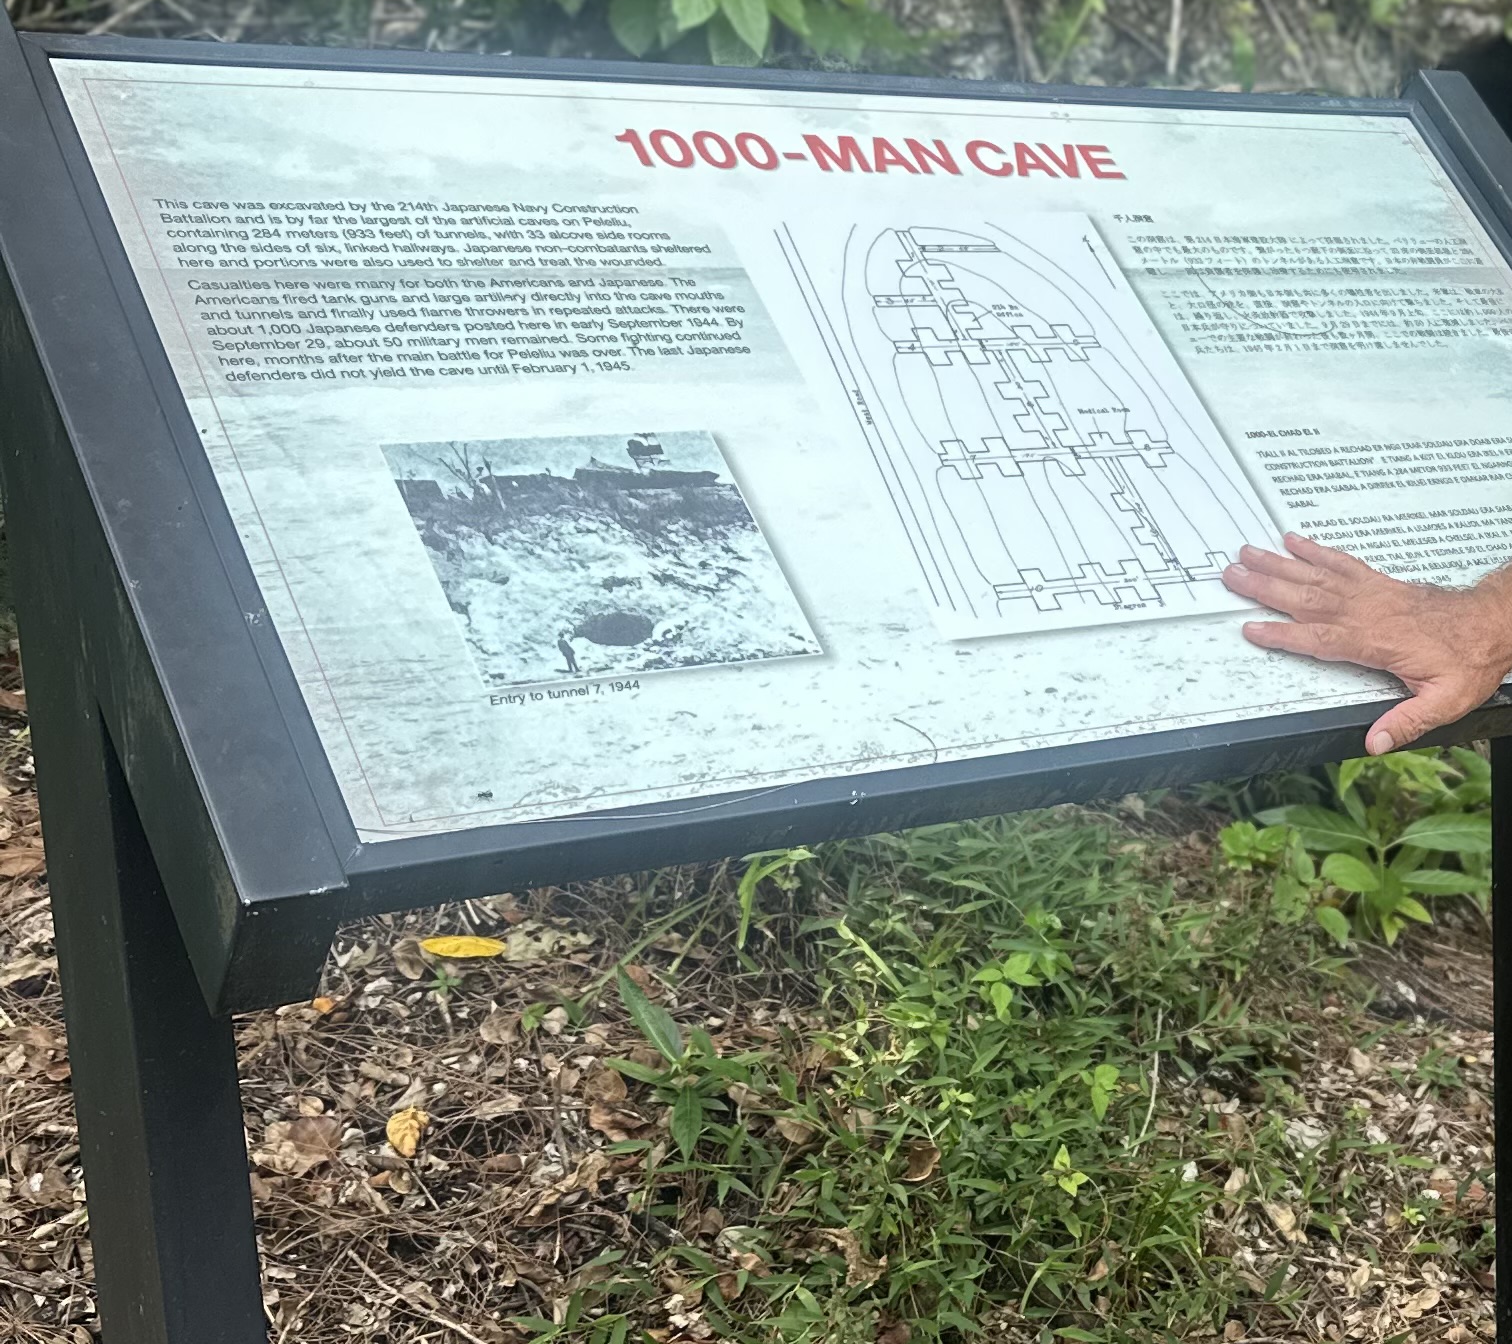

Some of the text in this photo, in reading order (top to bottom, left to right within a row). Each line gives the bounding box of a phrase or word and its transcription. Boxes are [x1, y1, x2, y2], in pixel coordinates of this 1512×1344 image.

[615, 127, 1126, 180] 1000-MAN CAVE
[153, 199, 187, 209] This
[193, 201, 228, 209] cave
[269, 201, 345, 211] excavated
[349, 201, 366, 212] by
[371, 202, 396, 211] the
[400, 202, 437, 212] 214th
[442, 202, 510, 213] Japanese
[514, 203, 548, 214] Navy
[552, 203, 639, 214] Construction
[160, 213, 230, 224] Battalion
[236, 214, 264, 224] and
[269, 214, 283, 224] is
[286, 214, 303, 226] by
[309, 215, 328, 224] far
[333, 215, 357, 225] the
[360, 215, 411, 227] largest
[415, 216, 429, 225] of
[432, 216, 456, 225] the
[461, 216, 515, 226] artificial
[519, 217, 558, 226] caves
[562, 217, 580, 226] on
[167, 228, 249, 240] containing
[252, 229, 281, 238] 284
[286, 229, 338, 238] meters
[342, 229, 375, 240] (933
[379, 229, 412, 240] feet)
[417, 229, 430, 239] of
[493, 230, 524, 239] with
[526, 230, 544, 239] 33
[549, 230, 592, 240] alcove
[596, 231, 625, 240] side
[628, 232, 670, 240] rooms
[173, 243, 217, 254] along
[221, 243, 246, 253] the
[251, 243, 292, 253] sides
[296, 243, 312, 253] of
[344, 243, 389, 253] linked
[464, 243, 531, 254] Japanese
[535, 244, 648, 253] non-combatants
[651, 244, 711, 253] sheltered
[178, 257, 214, 267] here
[219, 258, 249, 267] and
[253, 258, 317, 269] portions
[321, 259, 358, 267] were
[362, 258, 393, 267] also
[398, 258, 434, 267] used
[437, 258, 452, 267] to
[456, 258, 504, 267] shelter
[508, 258, 535, 267] and
[539, 258, 572, 267] treat
[574, 258, 596, 267] the
[188, 280, 271, 290] Casualties
[274, 279, 310, 290] here
[314, 281, 351, 289] were
[355, 280, 395, 290] many
[400, 278, 419, 289] for
[424, 278, 458, 288] both
[461, 278, 486, 288] the
[490, 278, 565, 288] Americans
[568, 278, 594, 287] and
[668, 277, 696, 287] The
[195, 291, 724, 305] Americans fired tank guns and large artillery directly into the cave mouths
[200, 310, 230, 320] and
[235, 310, 293, 320] tunnels
[297, 309, 327, 319] and
[331, 308, 374, 320] finally
[379, 308, 417, 318] used
[420, 307, 462, 317] flame
[465, 307, 529, 316] throwers
[533, 306, 545, 316] in
[549, 306, 611, 317] repeated
[669, 304, 710, 313] There
[712, 305, 745, 313] were
[207, 325, 255, 336] about
[257, 324, 301, 336] 1,000
[306, 324, 381, 335] Japanese
[385, 322, 460, 332] defenders
[464, 321, 515, 333] posted
[517, 320, 551, 330] here
[554, 320, 567, 329] in
[571, 319, 603, 330] early
[608, 318, 682, 330] September
[725, 317, 743, 329] By
[212, 340, 300, 352] September
[335, 338, 378, 348] about
[383, 337, 402, 347] 50
[407, 337, 460, 348] military
[465, 337, 498, 345] men
[576, 333, 617, 343] Some
[621, 332, 673, 345] fighting
[676, 331, 741, 341] continued
[264, 355, 324, 365] months
[328, 354, 363, 364] after
[368, 353, 393, 363] the
[397, 352, 434, 362] main
[437, 351, 480, 361] battle
[484, 350, 503, 360] for
[508, 349, 555, 359] Peleliu
[559, 350, 589, 358] was
[627, 346, 655, 356] The
[657, 346, 684, 356] last
[687, 345, 751, 357] Japanese
[226, 370, 307, 381] defenders
[312, 369, 336, 379] did
[341, 368, 367, 378] not
[369, 367, 407, 379] yield
[410, 366, 435, 377] the
[439, 367, 474, 375] cave
[478, 365, 509, 374] until
[512, 363, 576, 375] February
[490, 680, 640, 705] Entry to tunnel 7, 1944
